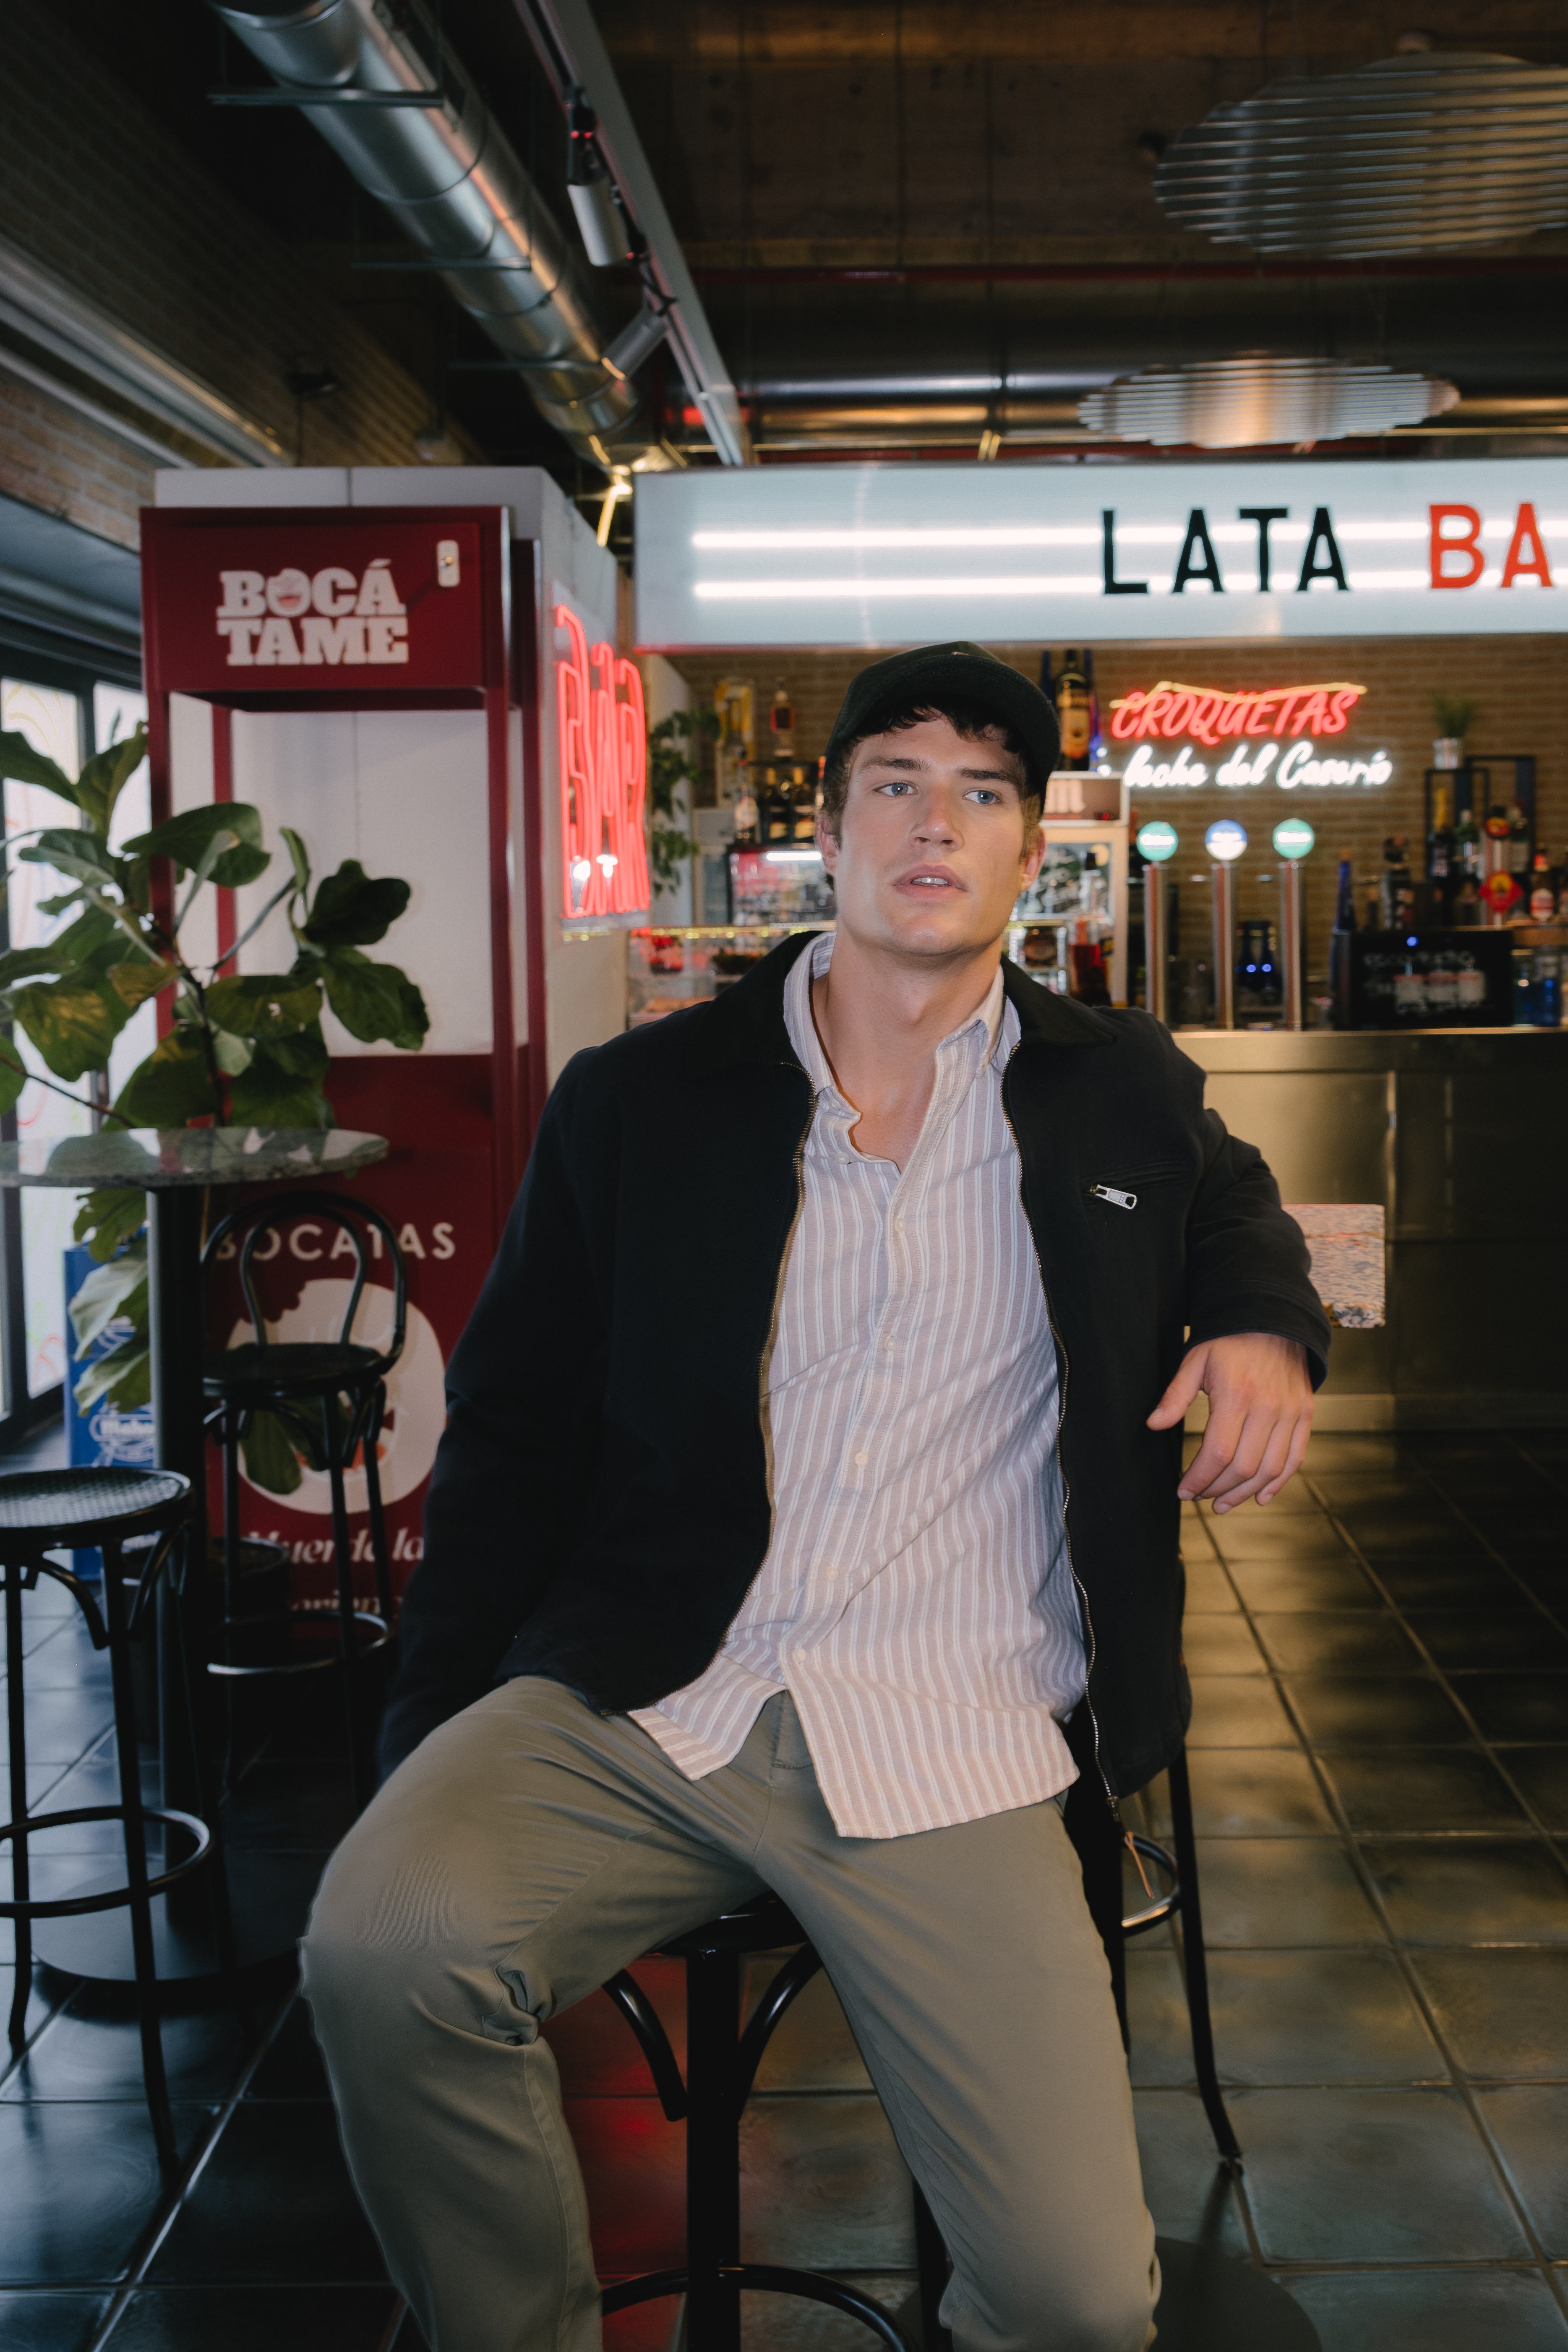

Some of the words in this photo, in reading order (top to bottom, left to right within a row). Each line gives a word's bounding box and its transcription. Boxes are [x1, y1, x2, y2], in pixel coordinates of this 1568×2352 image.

[1103, 507, 1349, 594] LATA
[1428, 502, 1554, 589] BA
[217, 616, 409, 666] TAME
[1111, 687, 1361, 744] CROQUETAS
